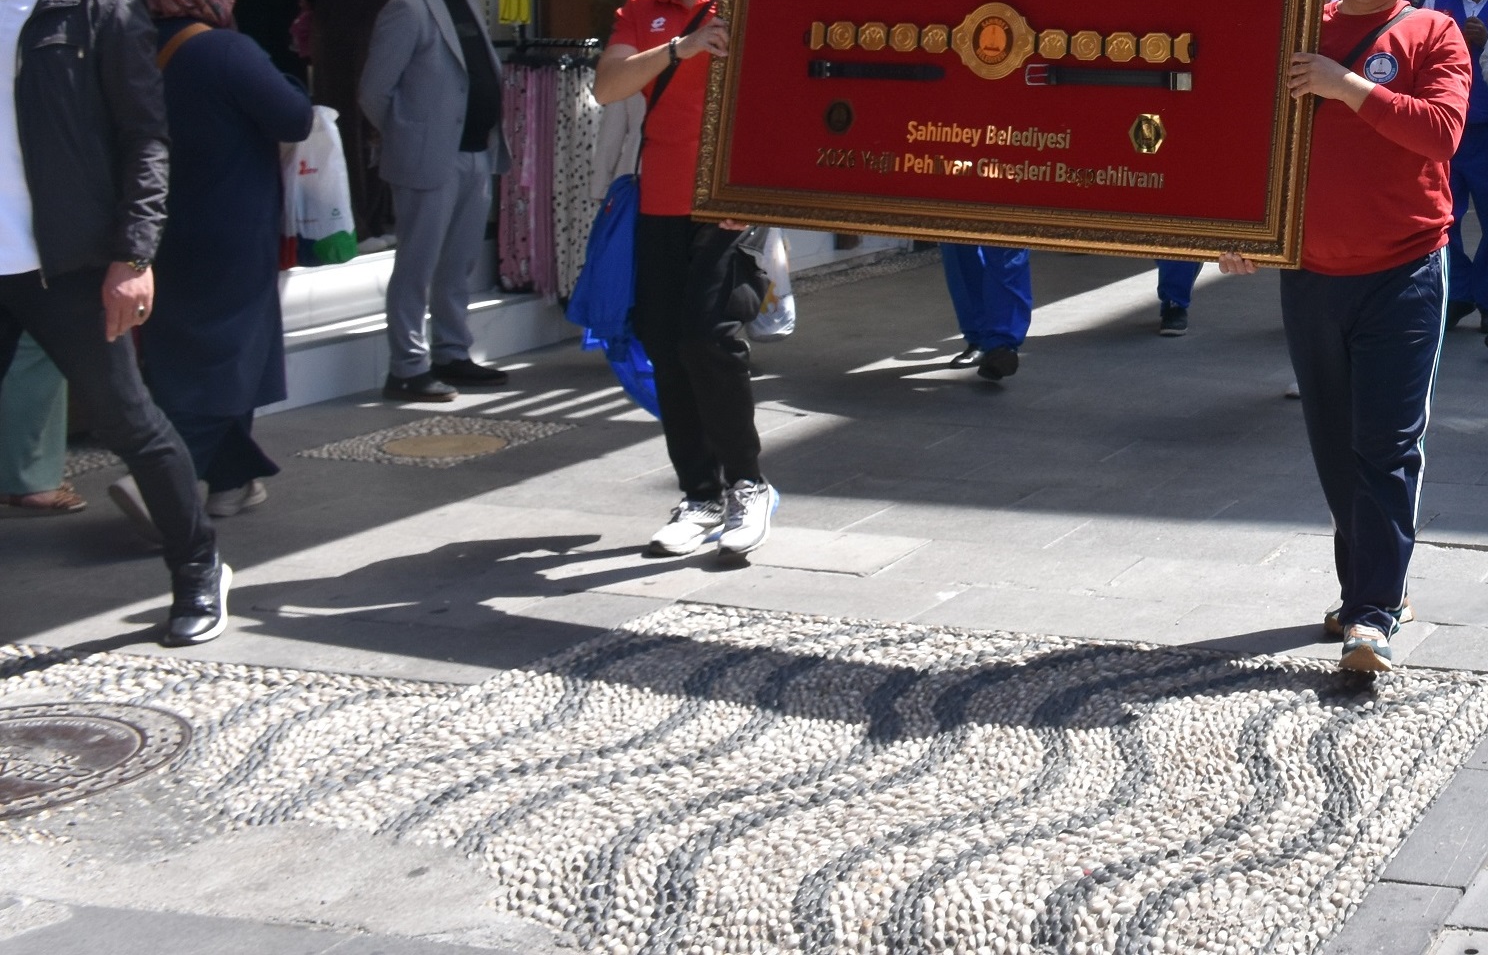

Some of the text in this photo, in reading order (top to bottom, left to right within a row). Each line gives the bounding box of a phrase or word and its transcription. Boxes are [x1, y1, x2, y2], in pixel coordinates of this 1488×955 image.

[906, 120, 1072, 151] Şahinbey Belediyesi
[815, 147, 855, 168] 2026
[904, 153, 973, 177] Pehlivan
[976, 157, 1052, 183] Güreşleri
[1054, 162, 1165, 189] Başpehlivanı
